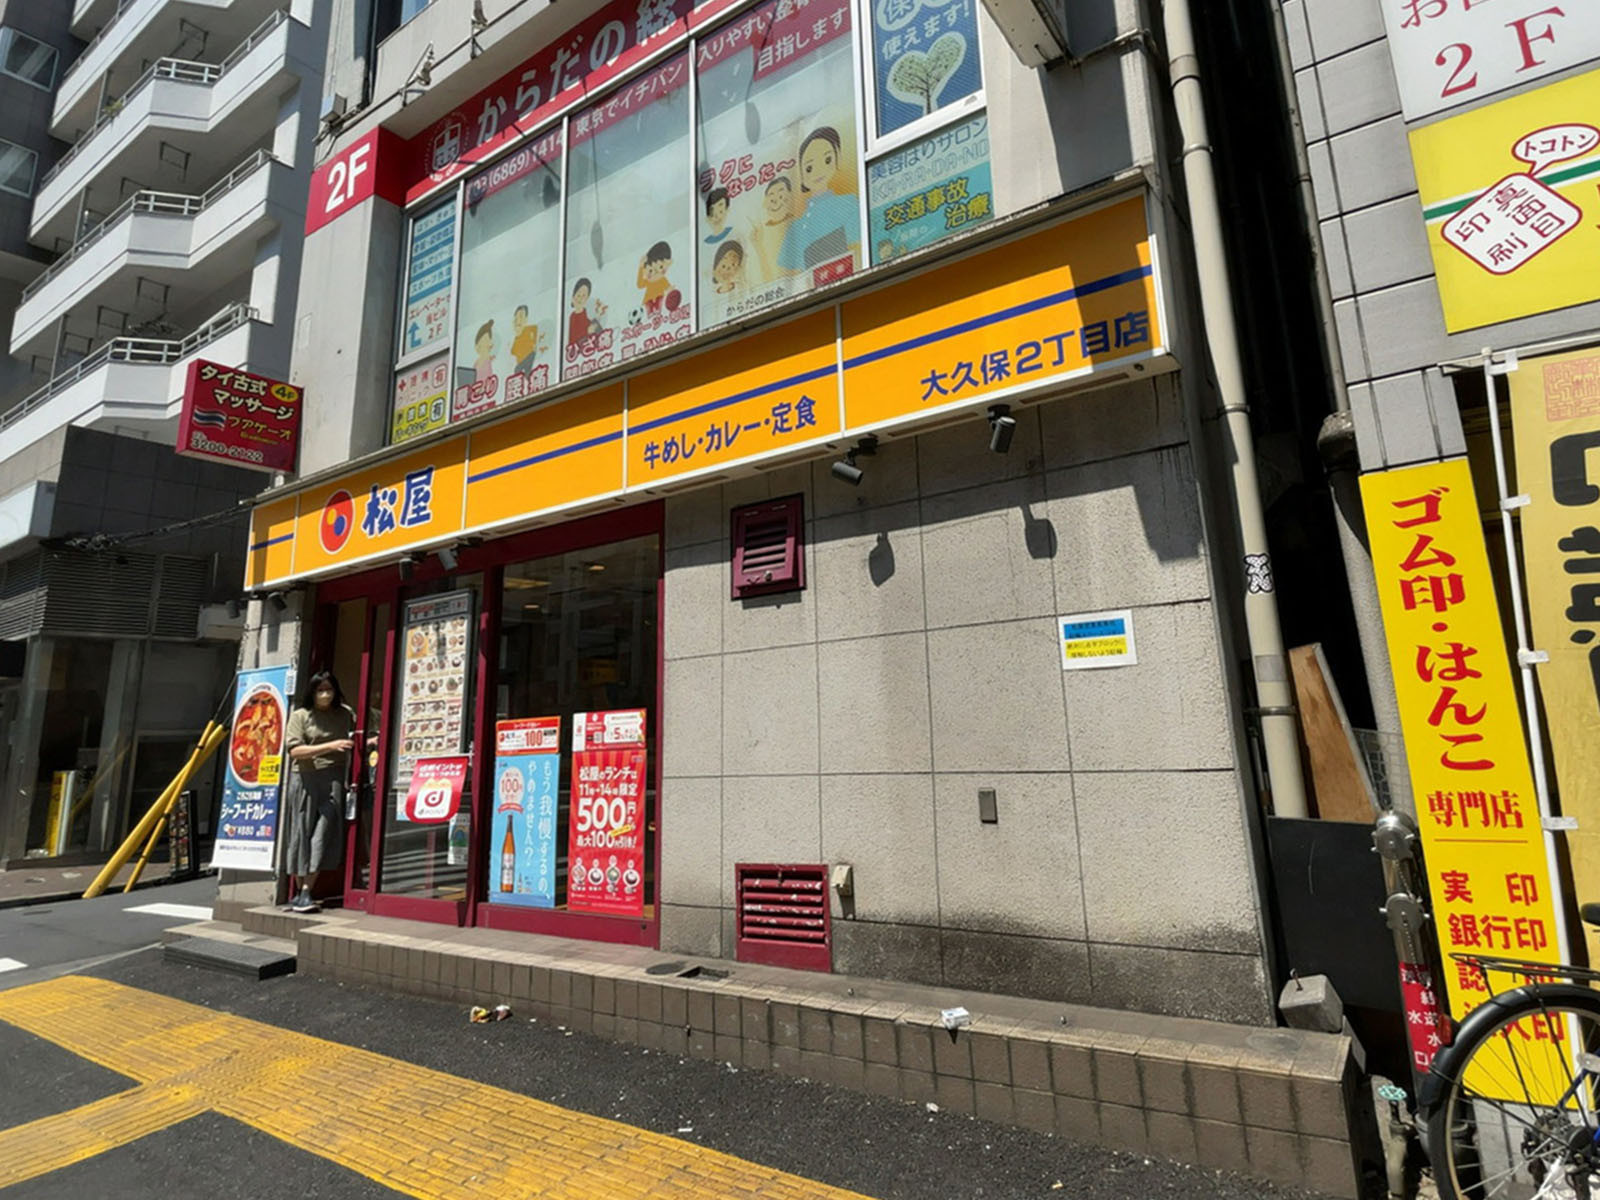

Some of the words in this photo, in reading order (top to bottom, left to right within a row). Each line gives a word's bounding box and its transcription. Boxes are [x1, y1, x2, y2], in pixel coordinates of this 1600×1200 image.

[757, 7, 848, 71] 目指します
[1435, 6, 1566, 98] 2F
[476, 0, 706, 148] からだの総
[575, 64, 683, 138] 東京でイチバン
[1523, 133, 1596, 158] トコトン
[325, 142, 370, 214] 2F
[700, 154, 753, 193] ラクに
[884, 177, 969, 230] 交通事故
[945, 192, 990, 229] 治療
[1455, 211, 1528, 266] 印刷
[201, 365, 268, 396] タイ古式
[920, 311, 1151, 401] 大久保2丁目店
[214, 388, 294, 420] マッサージ
[643, 395, 817, 470] 牛めし・カレー・定食
[361, 465, 435, 536] 松屋
[1392, 487, 1495, 771] ゴム印・はんこ
[220, 803, 274, 820] シーフードカレー
[1427, 790, 1524, 829] 専門店
[1447, 913, 1547, 951] 銀行印
